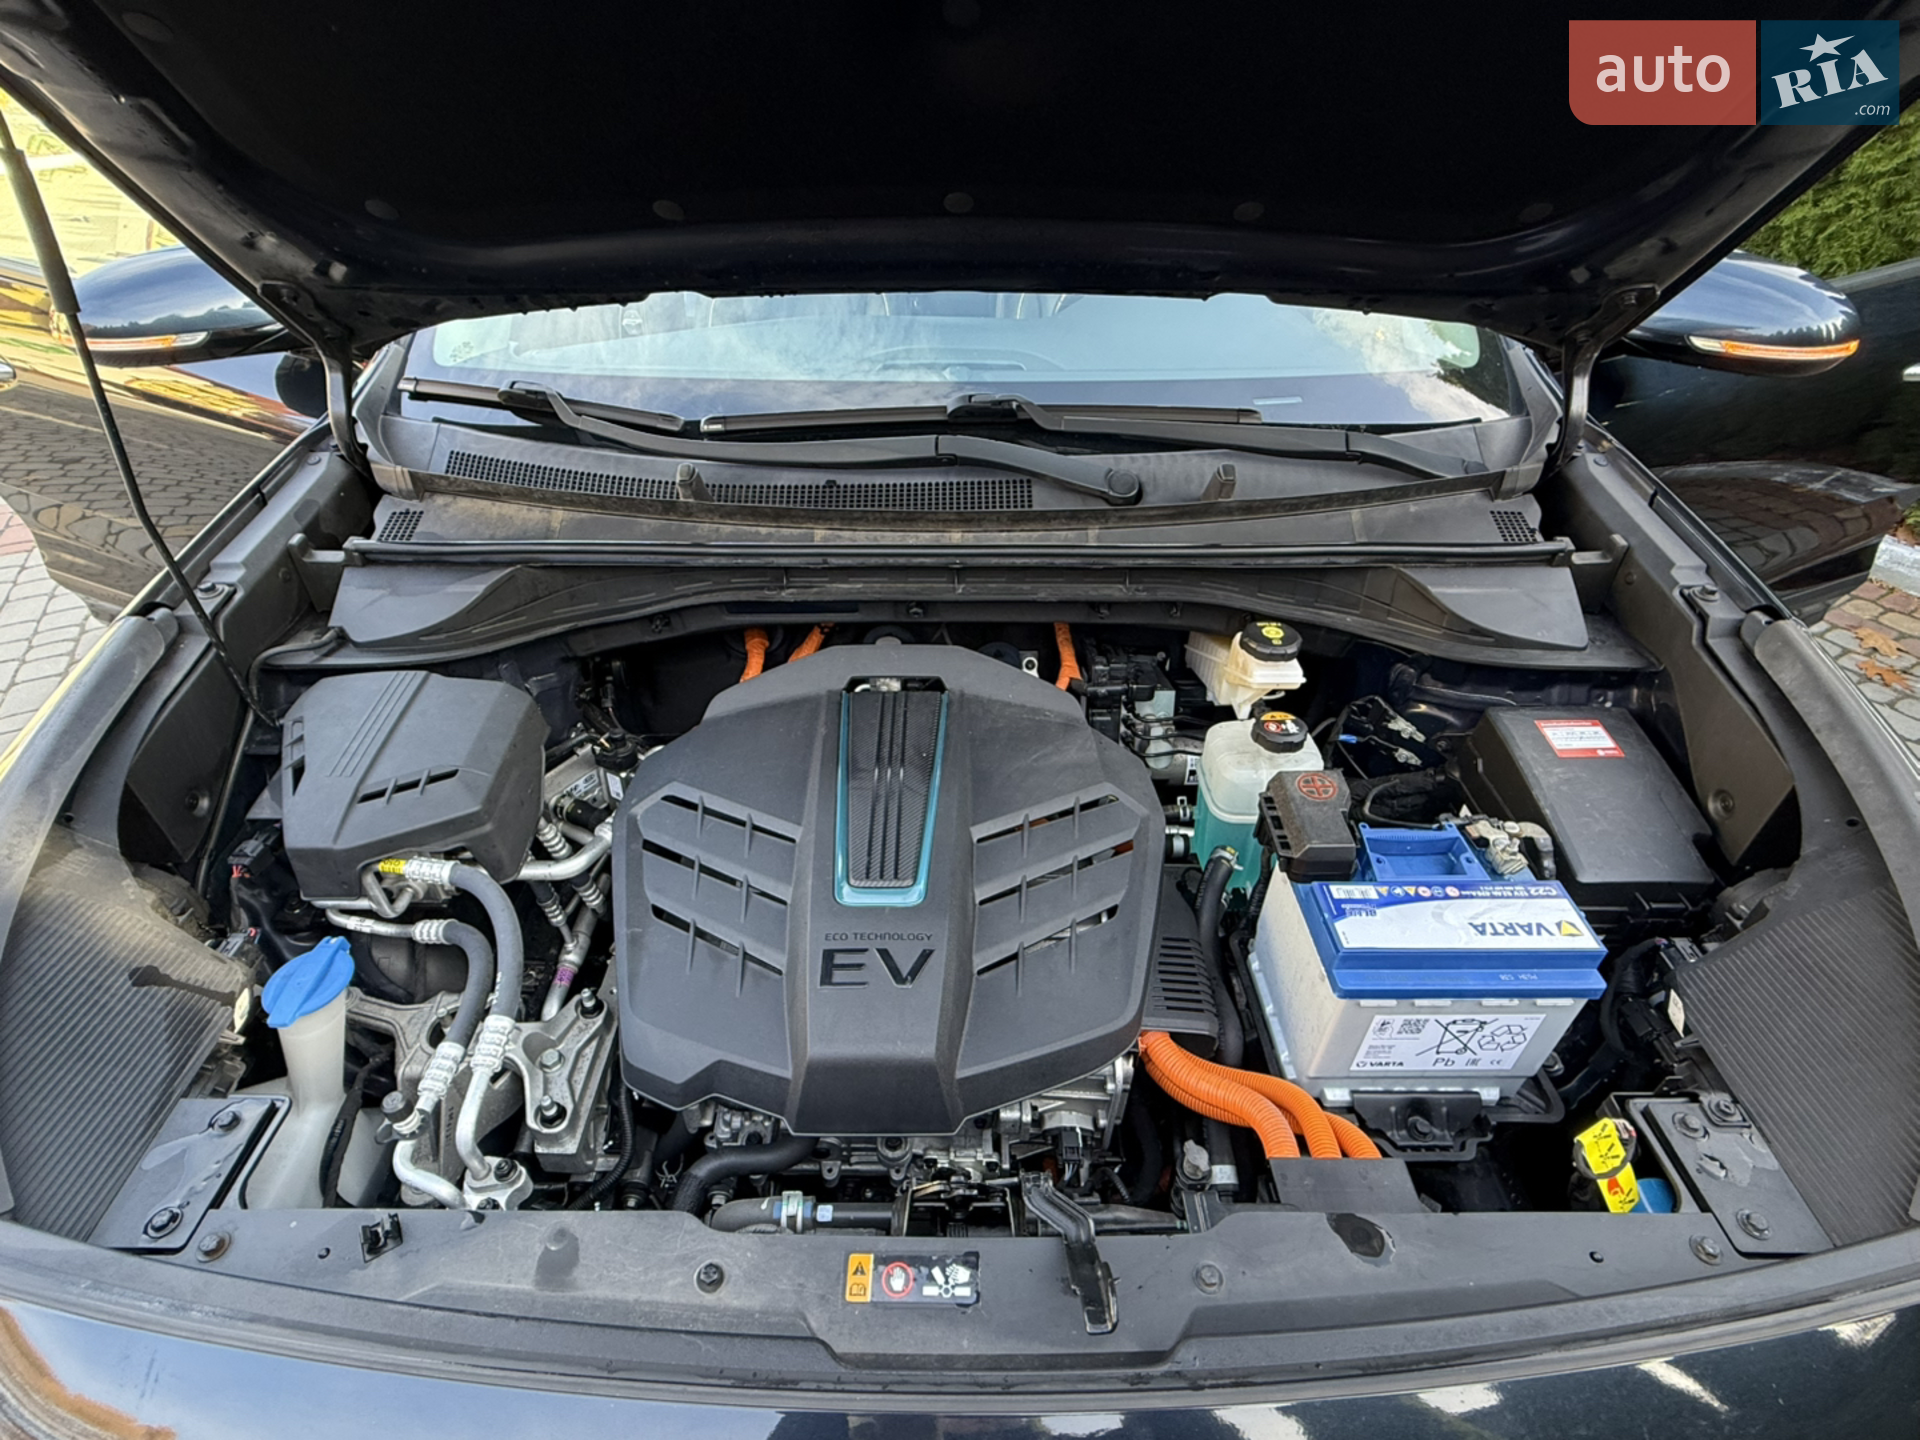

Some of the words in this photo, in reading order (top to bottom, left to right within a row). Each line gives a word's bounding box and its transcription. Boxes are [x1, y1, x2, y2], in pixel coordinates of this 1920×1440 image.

[1468, 922, 1556, 936] VARTA
[824, 932, 849, 942] ECO
[853, 932, 933, 942] TECHNOLOGY
[818, 948, 936, 989] EV
[1432, 1057, 1456, 1067] Pb
